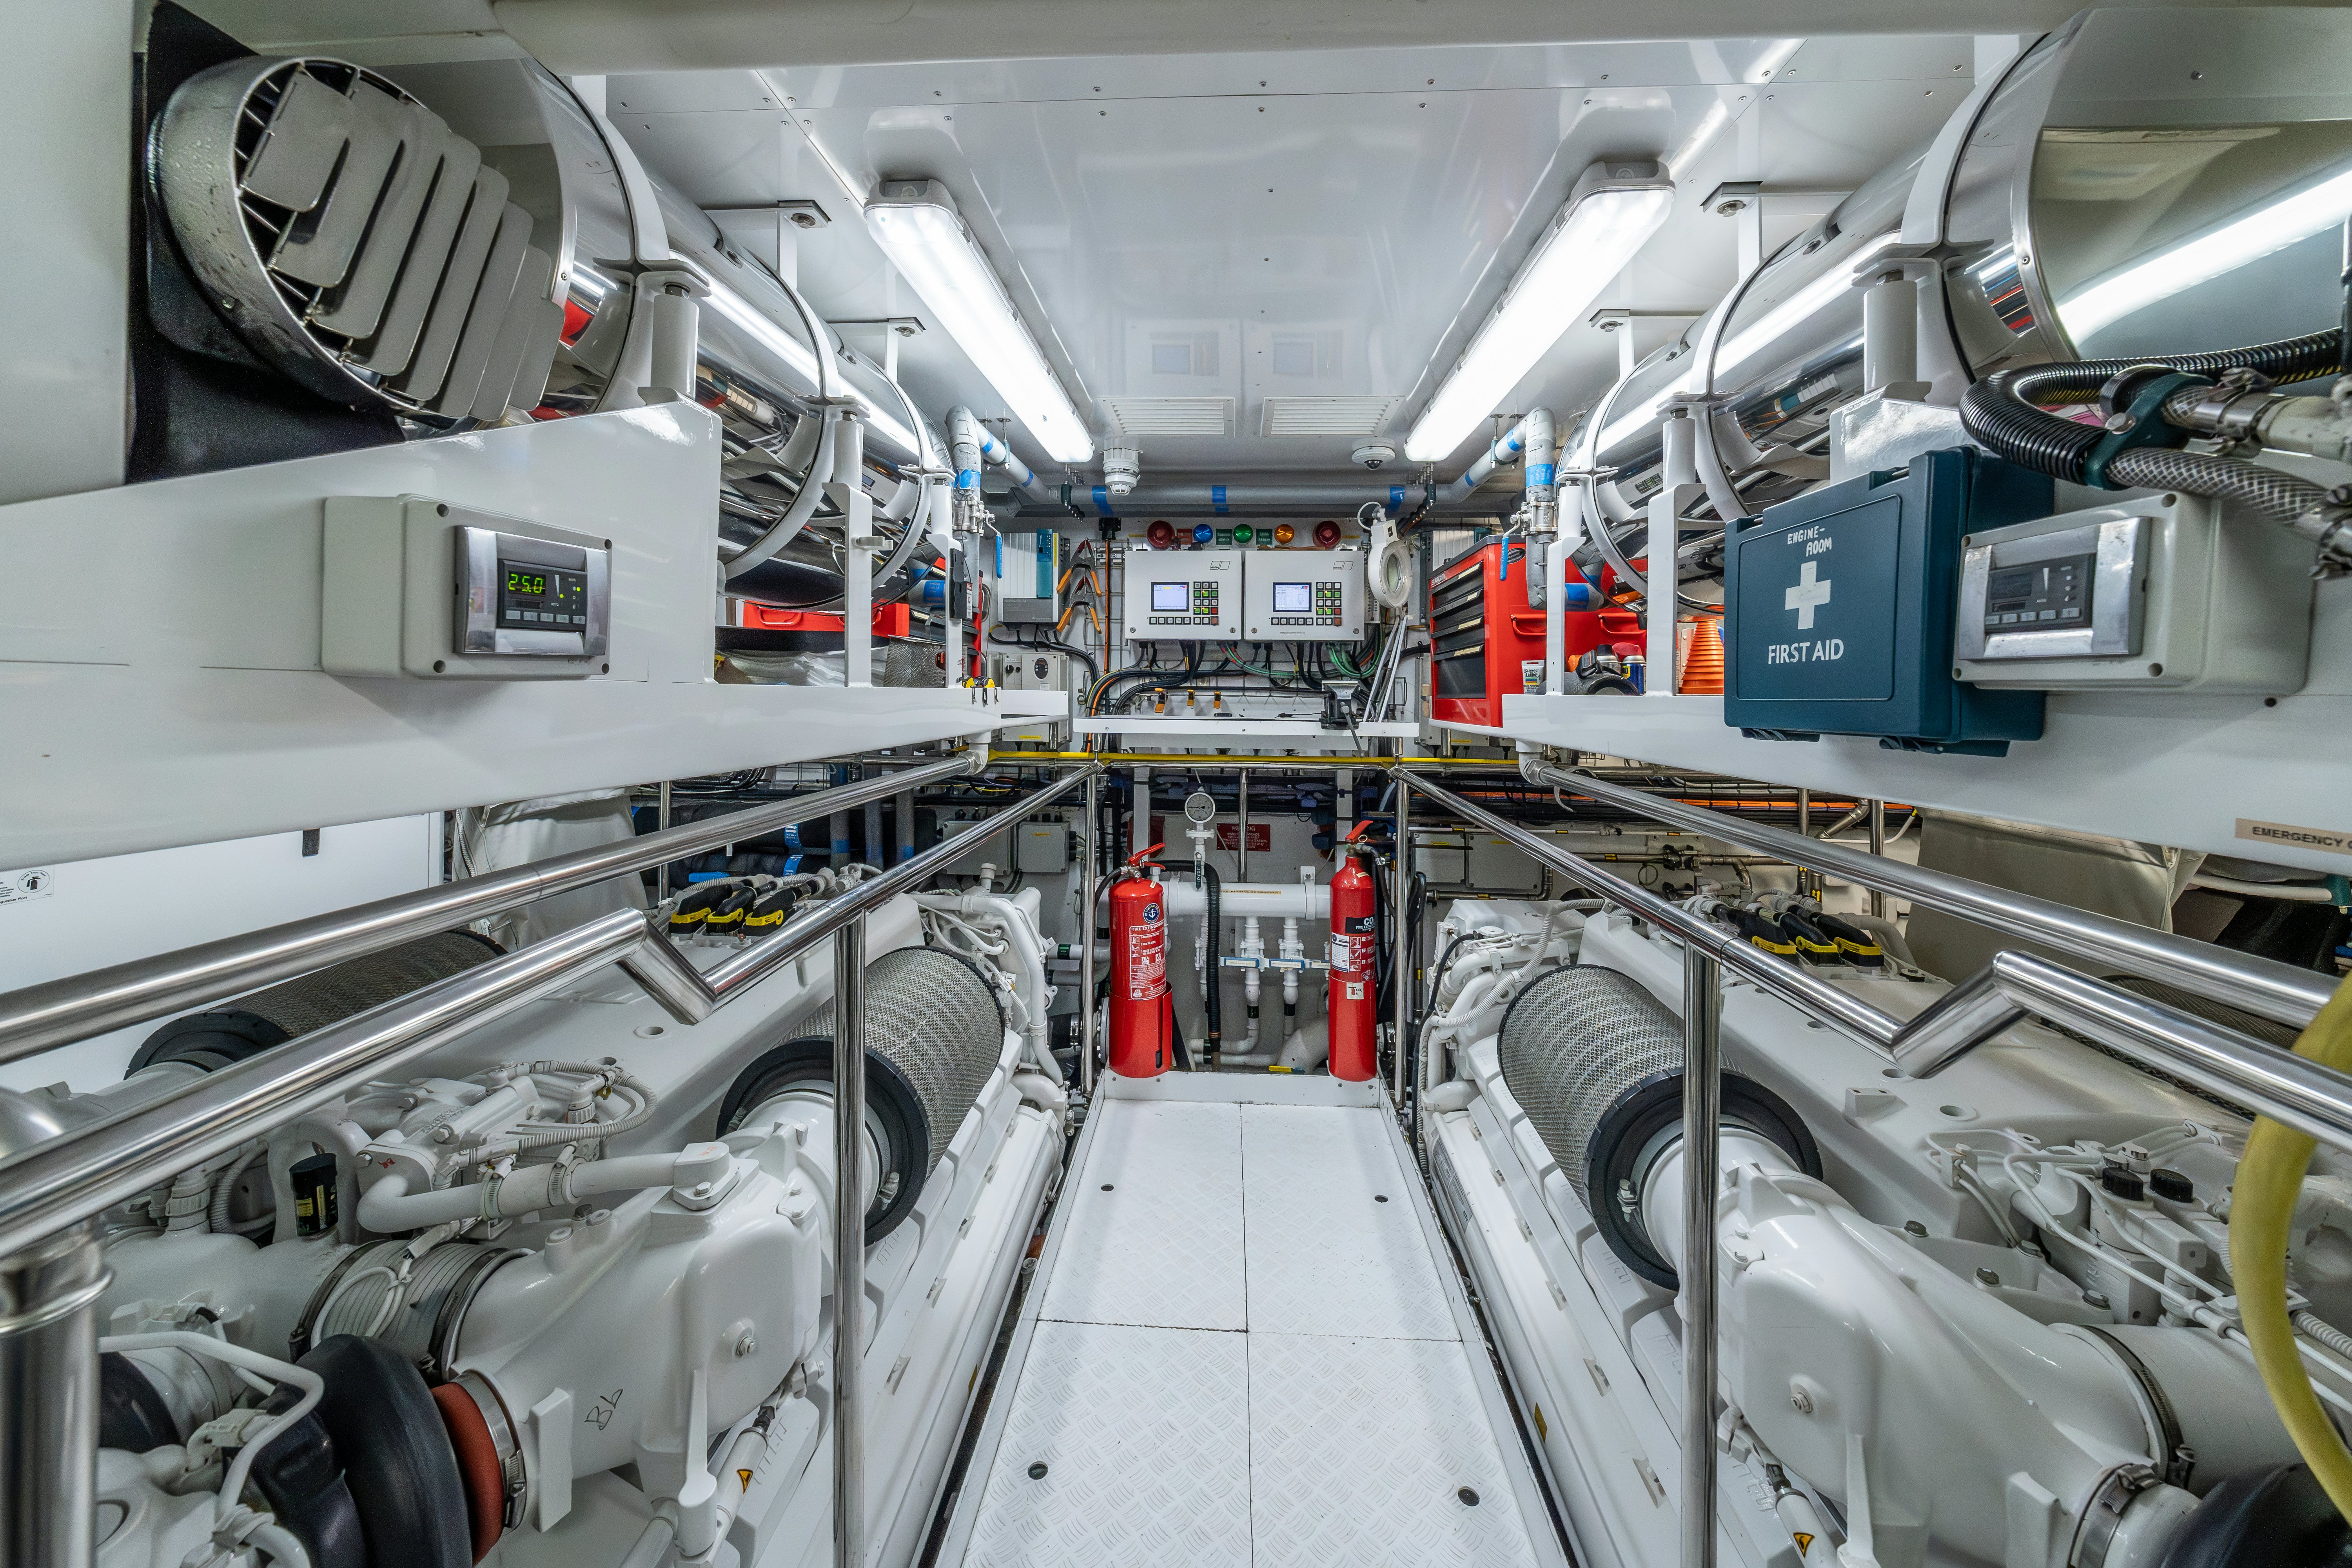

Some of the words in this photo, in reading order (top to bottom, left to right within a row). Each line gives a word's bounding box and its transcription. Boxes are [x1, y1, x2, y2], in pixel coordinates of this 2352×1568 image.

[1787, 526, 1825, 545] ENGINE-
[1806, 537, 1832, 557] ROOM
[508, 573, 543, 593] 25.0
[1768, 642, 1810, 664] FIRST
[1812, 639, 1844, 662] AID
[2252, 826, 2343, 847] EMERGENCY
